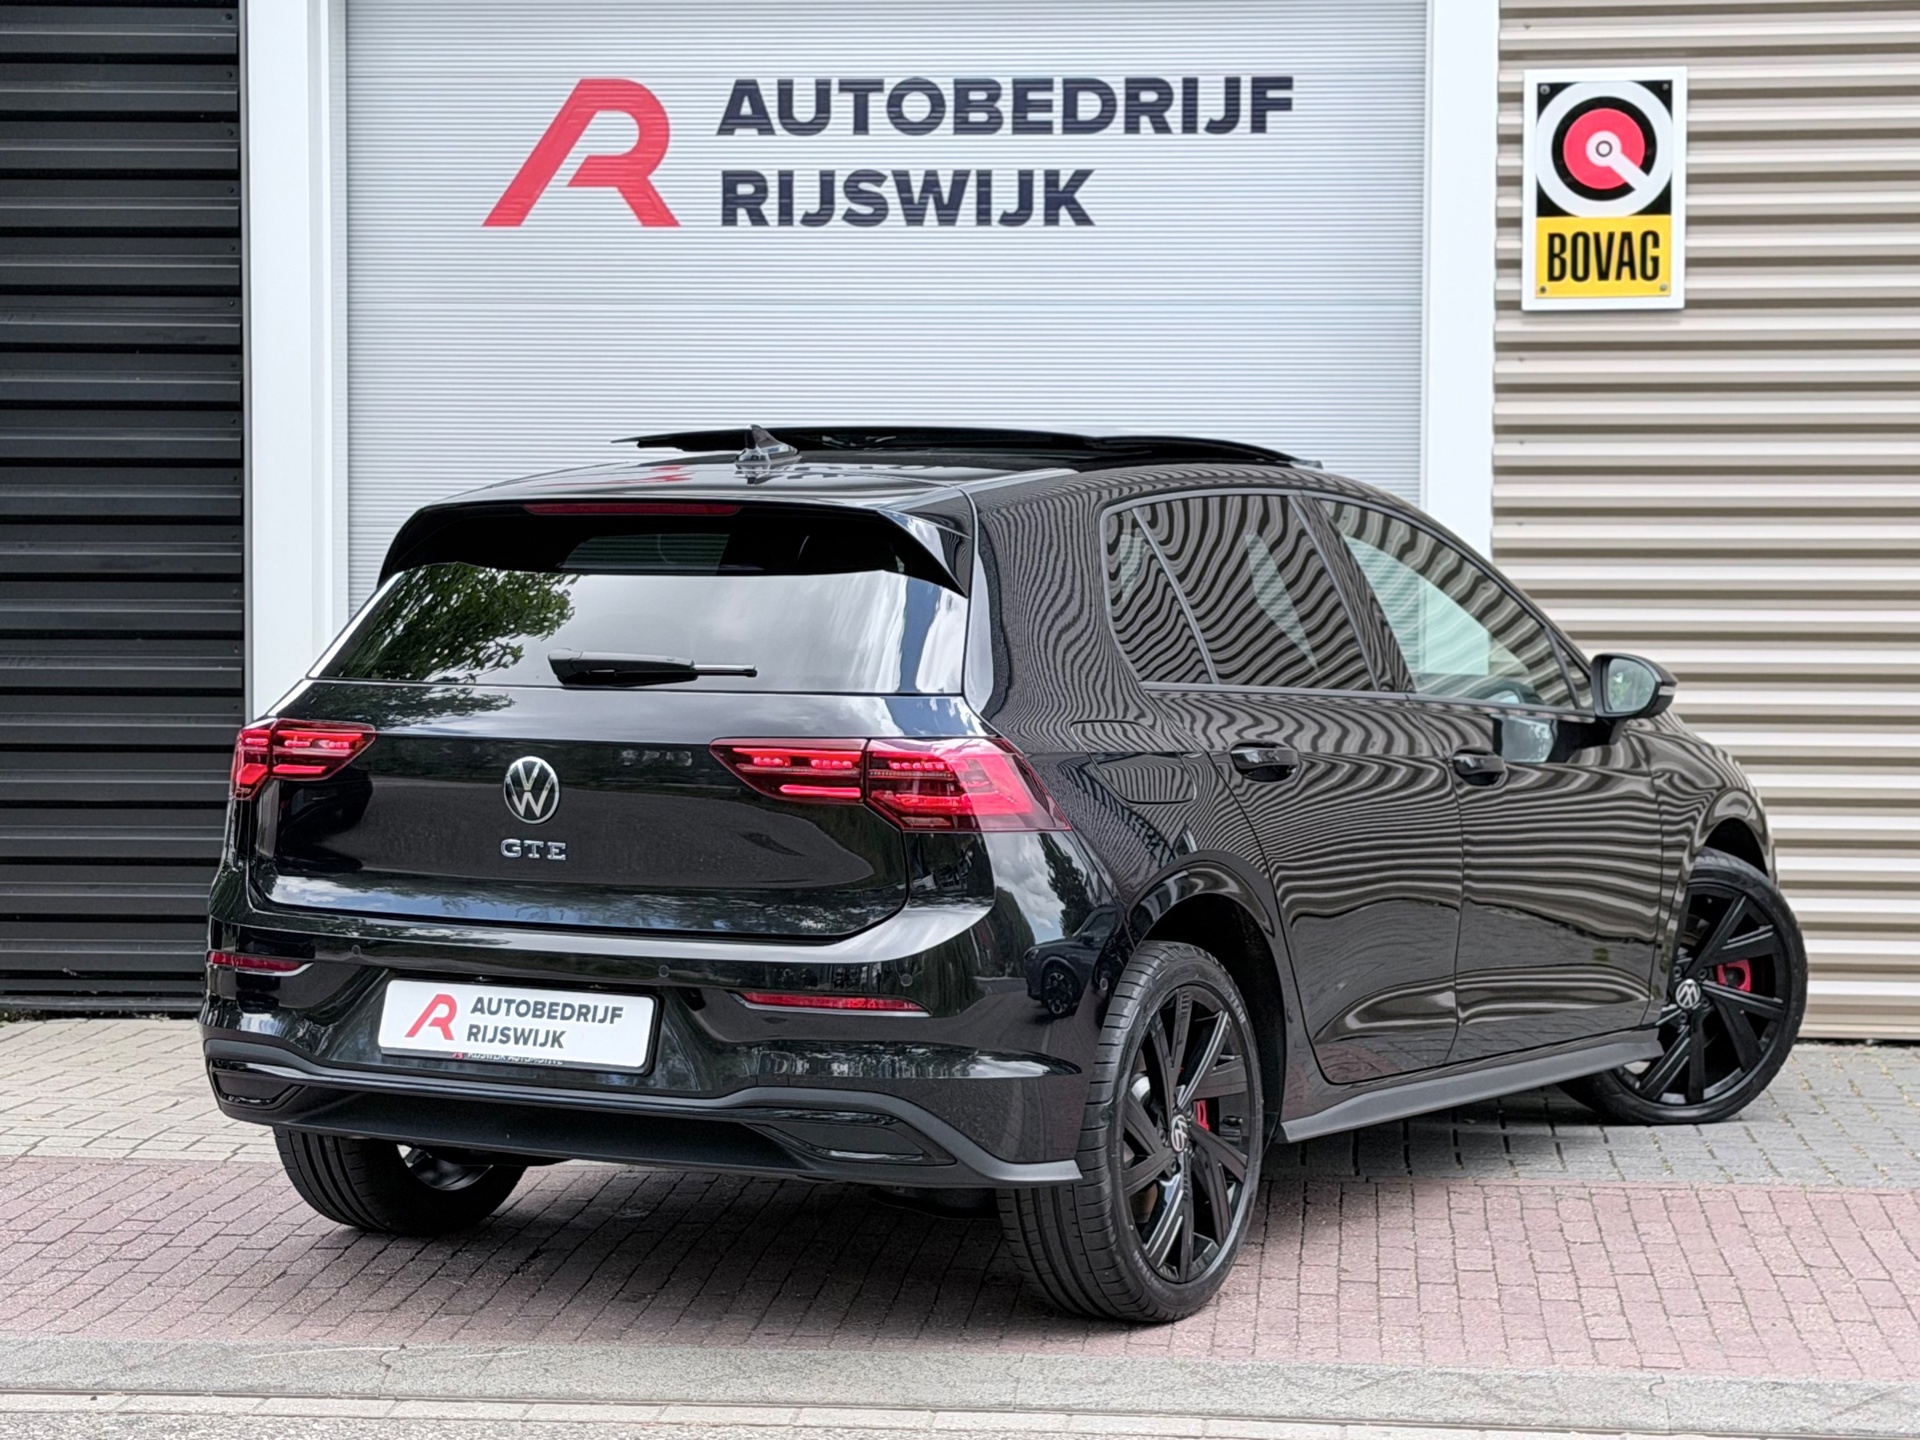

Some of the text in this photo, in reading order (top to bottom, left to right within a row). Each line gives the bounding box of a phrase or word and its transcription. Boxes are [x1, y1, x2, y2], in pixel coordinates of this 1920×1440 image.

[718, 76, 1294, 137] AUTOBEDRIJF
[721, 169, 1096, 227] RIJSWIJK
[1547, 230, 1660, 282] BOVAG
[500, 838, 567, 861] GTE
[470, 996, 624, 1025] AUTOBEDRIJF
[466, 1024, 567, 1049] RIJSWIJK
